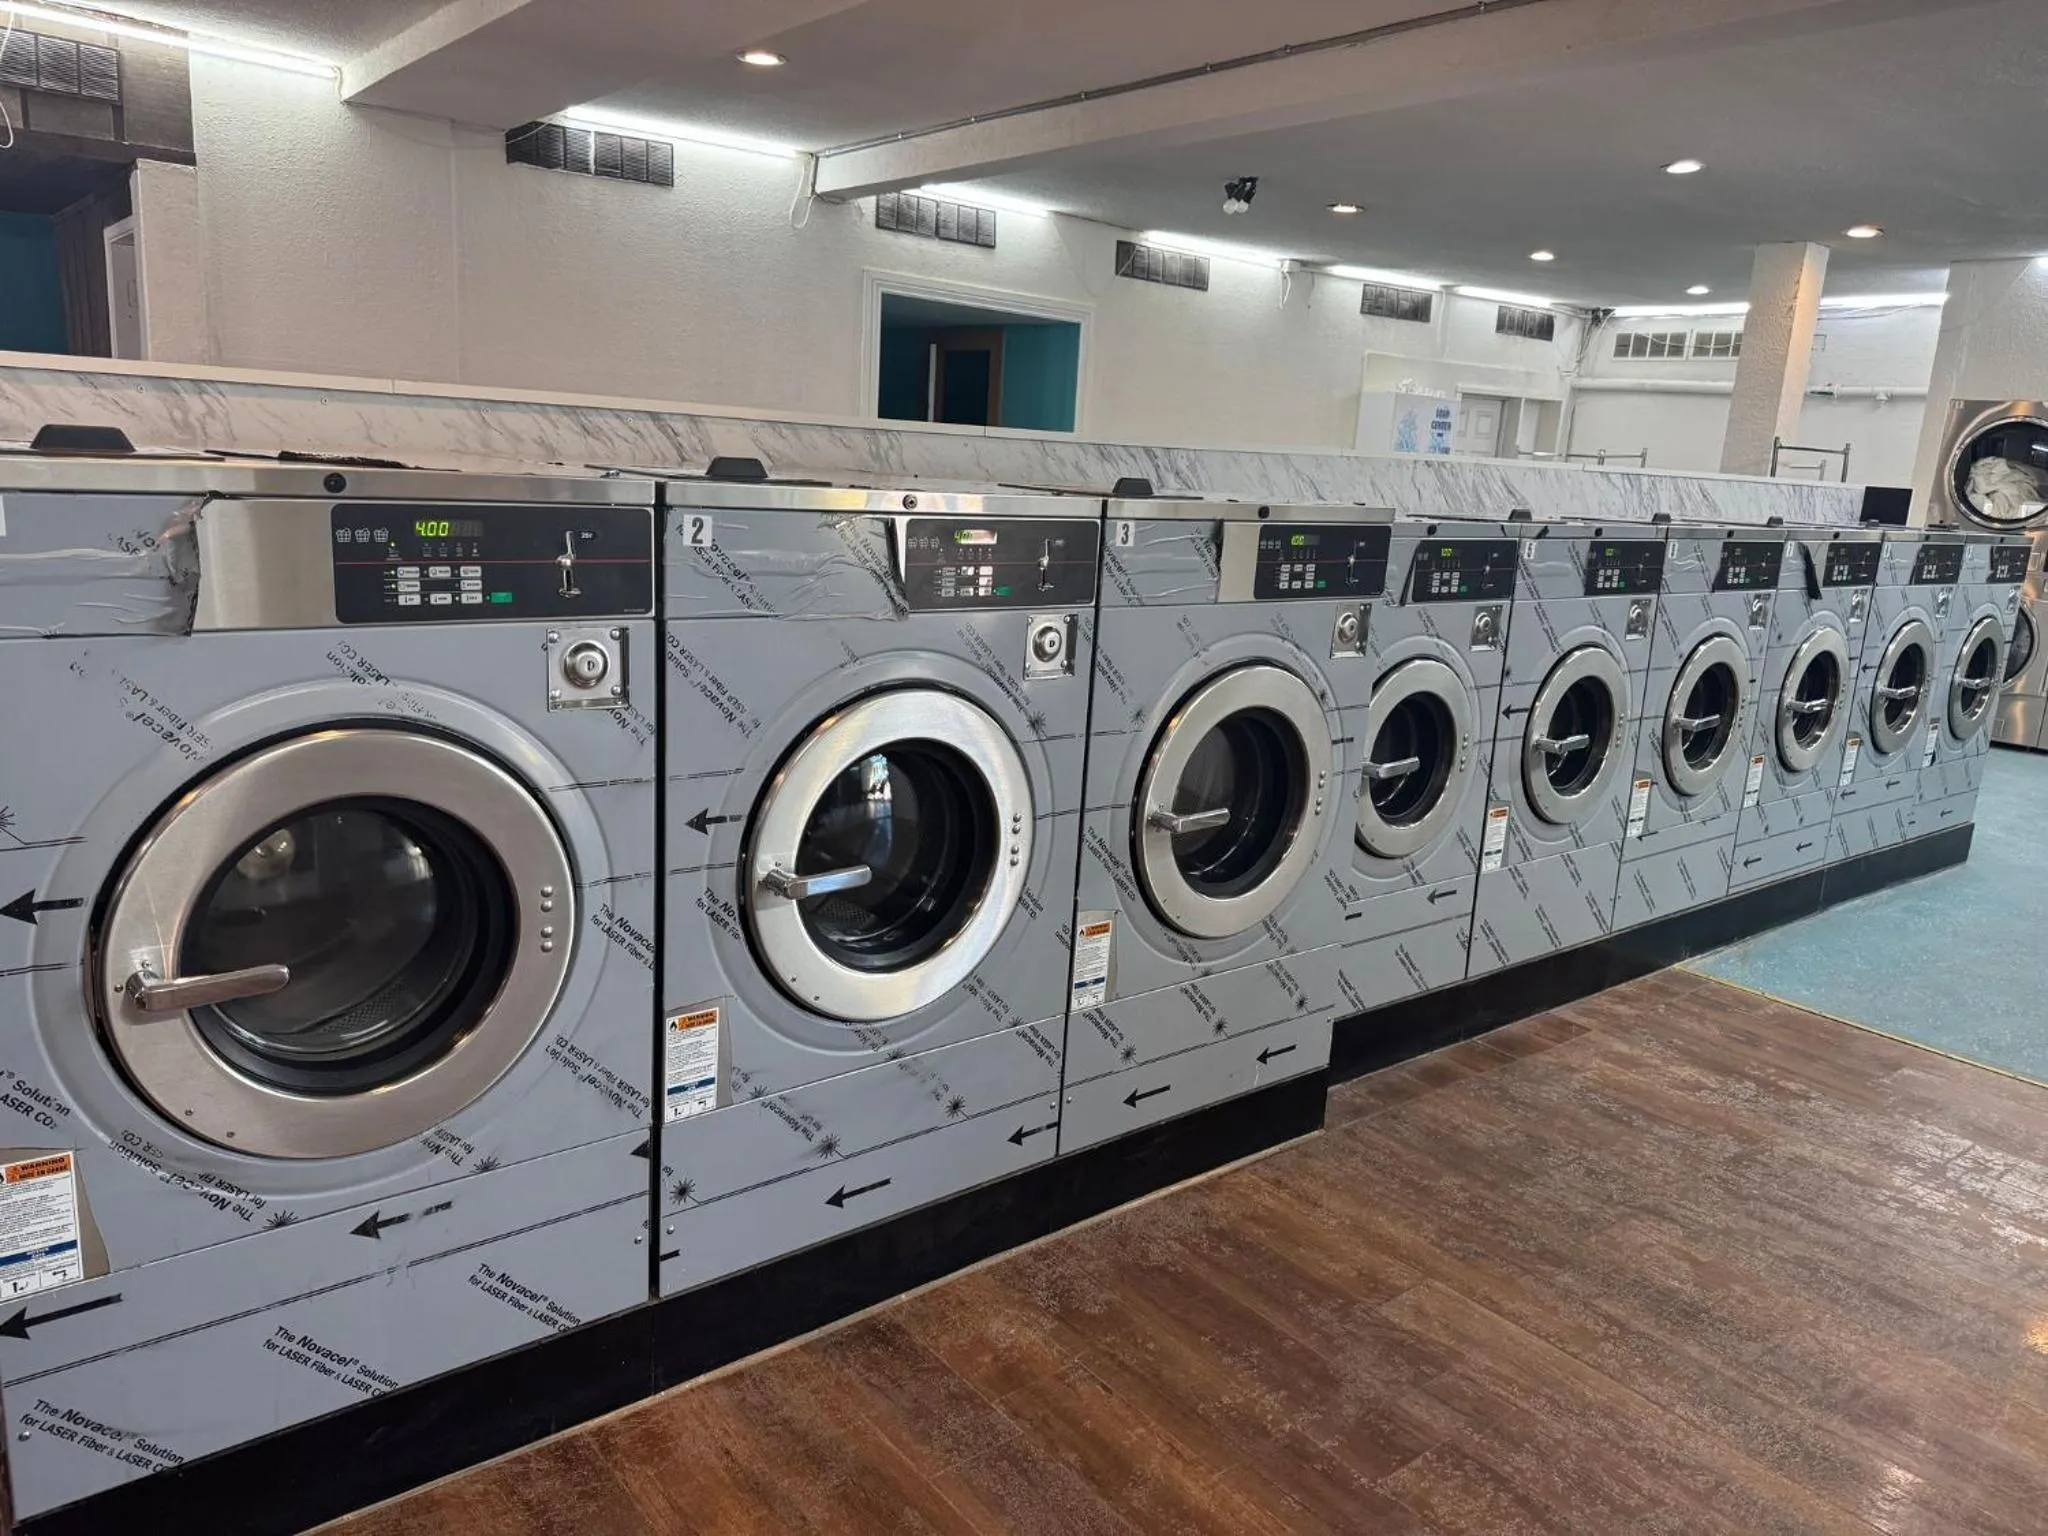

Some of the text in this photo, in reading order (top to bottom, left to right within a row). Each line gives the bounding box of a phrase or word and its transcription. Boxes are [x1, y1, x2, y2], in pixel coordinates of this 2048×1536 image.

[691, 517, 705, 545] 2
[1120, 523, 1131, 544] 3
[701, 886, 721, 905] The
[597, 902, 617, 921] The
[703, 905, 730, 930] LASER
[599, 922, 627, 946] LASER
[566, 1043, 594, 1067] LASER
[615, 1077, 642, 1100] LASER
[625, 1101, 644, 1118] The
[797, 1124, 816, 1143] The
[106, 1138, 163, 1176] Solution
[213, 1176, 250, 1203] LASER
[230, 1202, 255, 1223] The
[247, 1193, 267, 1211] for
[467, 1273, 482, 1287] for
[478, 1280, 507, 1302] LASER
[505, 1295, 528, 1313] Fiber
[531, 1309, 558, 1328] LASER
[476, 1262, 497, 1280] The
[544, 1299, 582, 1325] Solution
[262, 1337, 280, 1353] for
[277, 1344, 310, 1368] LASER
[308, 1358, 336, 1379] Fiber
[339, 1373, 371, 1396] LASER
[273, 1324, 297, 1344] The
[354, 1362, 399, 1392] Solution
[19, 1414, 40, 1426] for
[38, 1421, 75, 1442] LASER
[77, 1435, 108, 1455] Fiber
[115, 1450, 153, 1471] LASER
[33, 1399, 59, 1417] The
[133, 1438, 185, 1464] Solution
